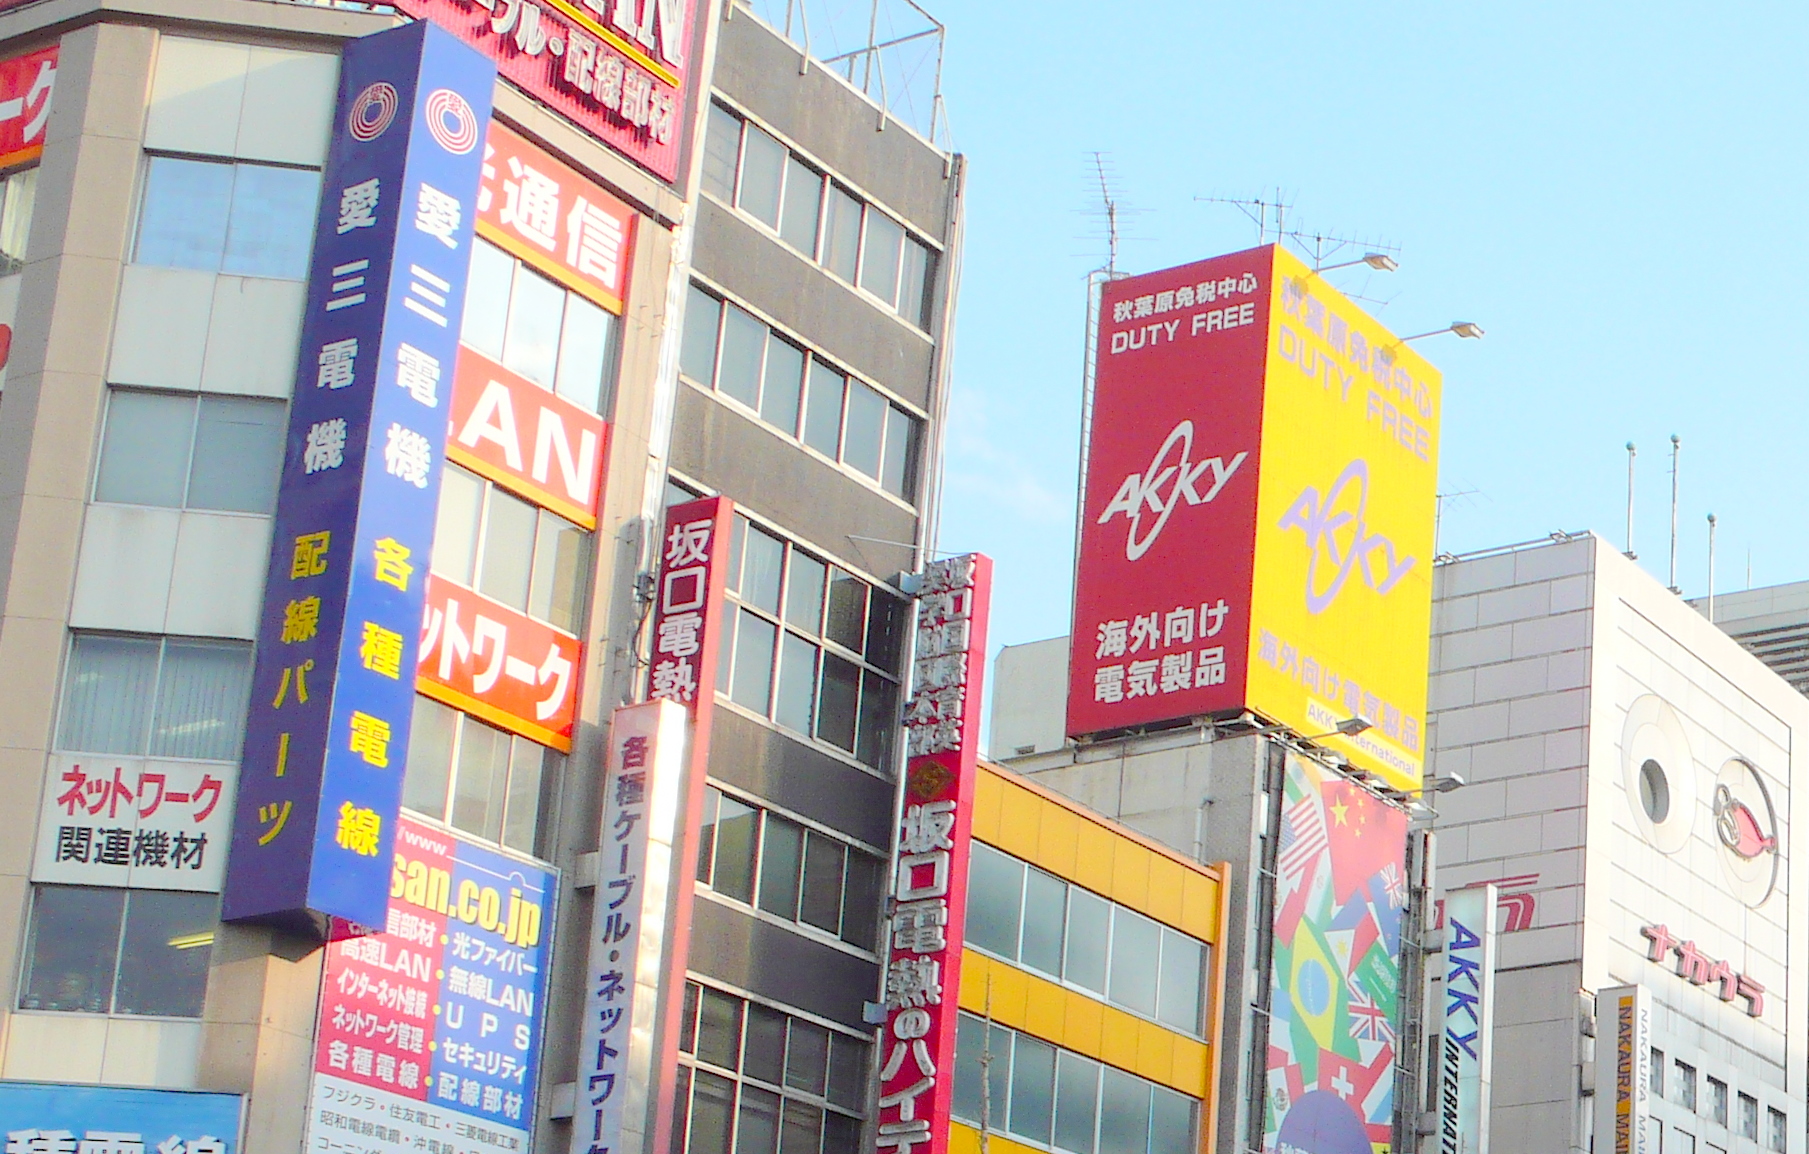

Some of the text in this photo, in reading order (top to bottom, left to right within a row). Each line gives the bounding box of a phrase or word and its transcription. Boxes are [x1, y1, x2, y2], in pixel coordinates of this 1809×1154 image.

[1111, 302, 1255, 355] DUTY FREE
[1114, 271, 1258, 325] 秋葉原免税中心
[1278, 324, 1430, 463] DUTY FREE
[1280, 274, 1432, 420] 秋葉原免税中心
[449, 378, 597, 505] AN
[652, 518, 712, 702] 坂口電熱
[1095, 599, 1229, 660] 海外向け
[258, 530, 329, 846] 配線パーツ
[336, 536, 414, 858] 各種電線
[420, 612, 576, 719] ットワーク
[1094, 646, 1226, 704] 電気製品
[1258, 627, 1419, 751] 海外向け電気製品
[57, 764, 224, 822] ネットワーク
[55, 825, 208, 872] 関連機材
[449, 966, 535, 1017] 無線LAN
[1444, 917, 1481, 1060] AKKY
[1642, 923, 1765, 1018] ナカウラ
[332, 1005, 424, 1054] ネットワーク管理
[443, 1037, 527, 1084] セキュリティ
[1613, 1005, 1631, 1104] NAKAURA
[328, 1040, 523, 1120] 各種電線 配線部材
